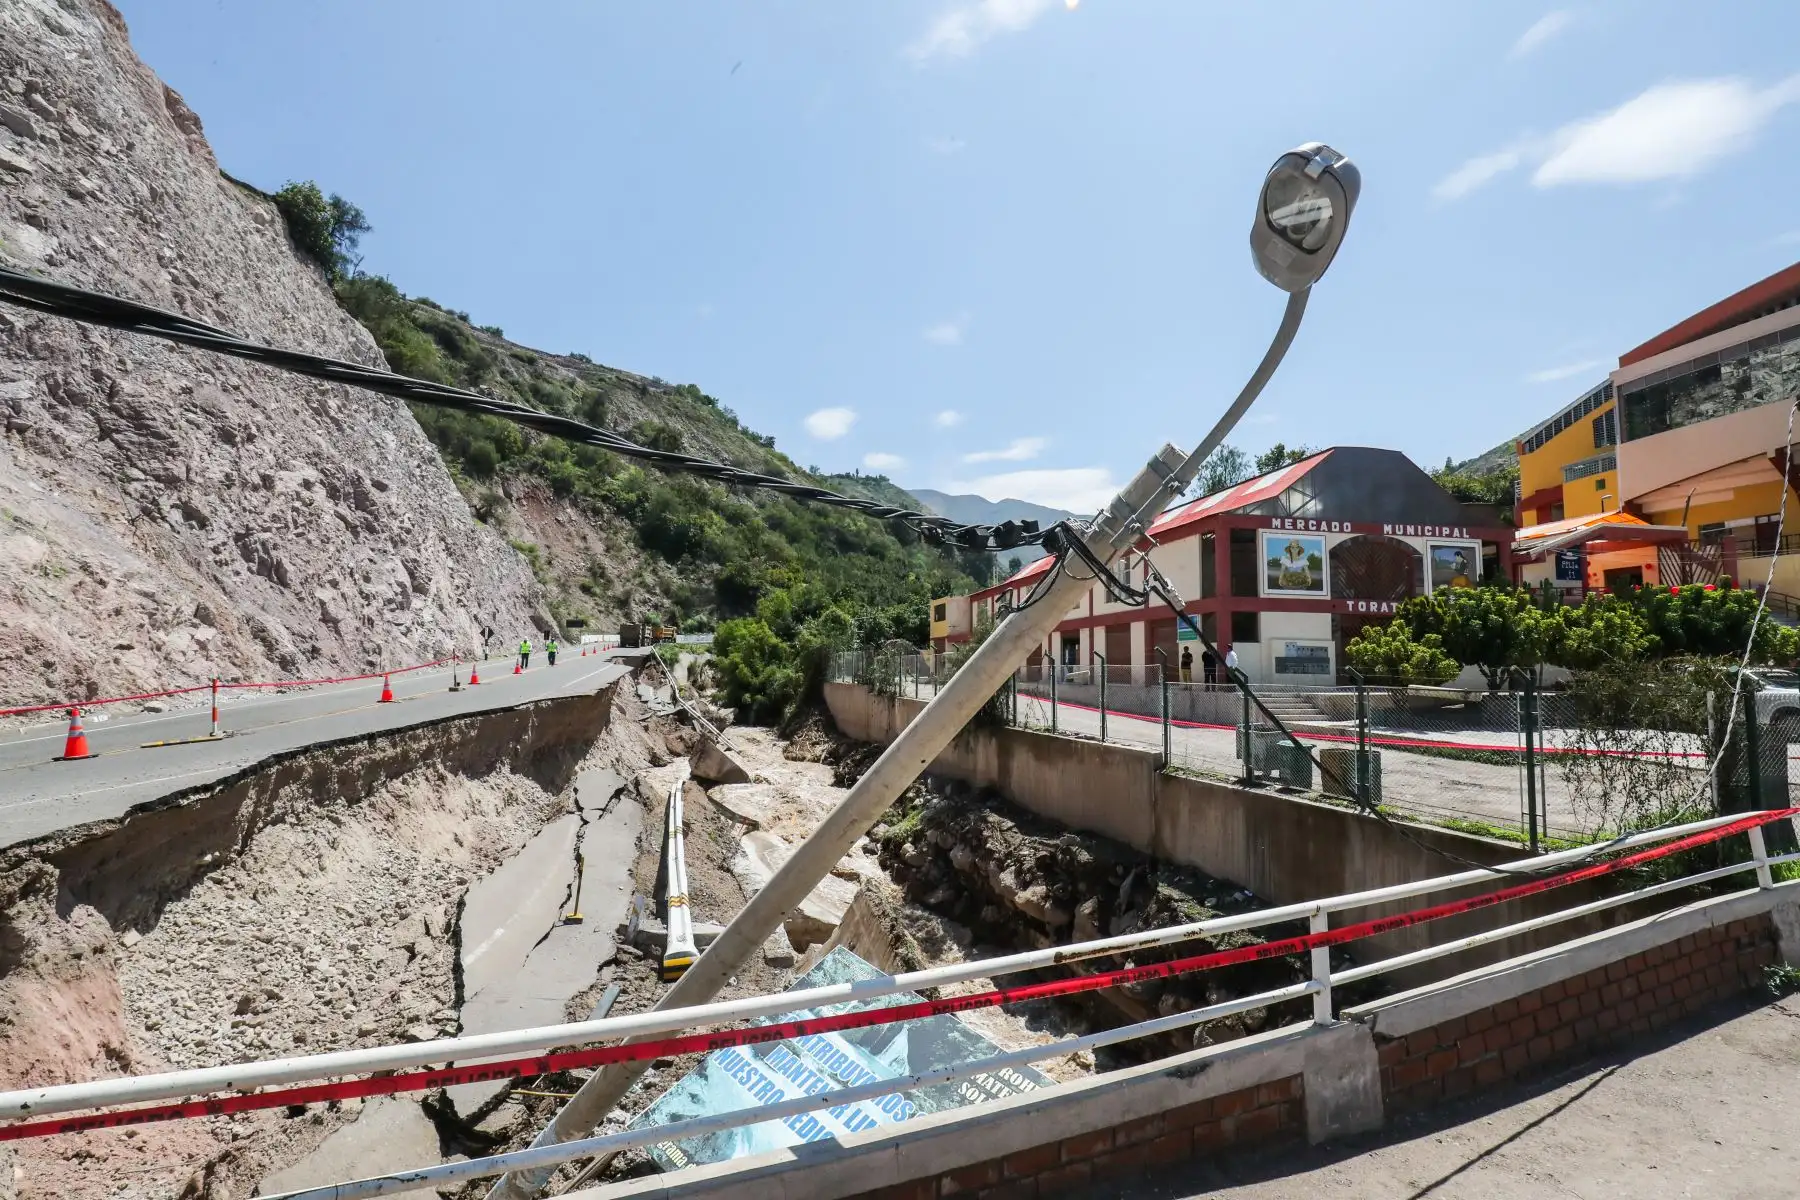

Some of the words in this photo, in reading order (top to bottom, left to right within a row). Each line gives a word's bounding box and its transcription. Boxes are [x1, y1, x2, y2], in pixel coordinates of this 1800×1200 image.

[1271, 518, 1352, 533] MERCADO
[1383, 524, 1470, 539] MUNICIPAL
[713, 1047, 786, 1106] NUESTRO
[764, 1045, 850, 1120] MANTER
[970, 1072, 1019, 1099] MATE
